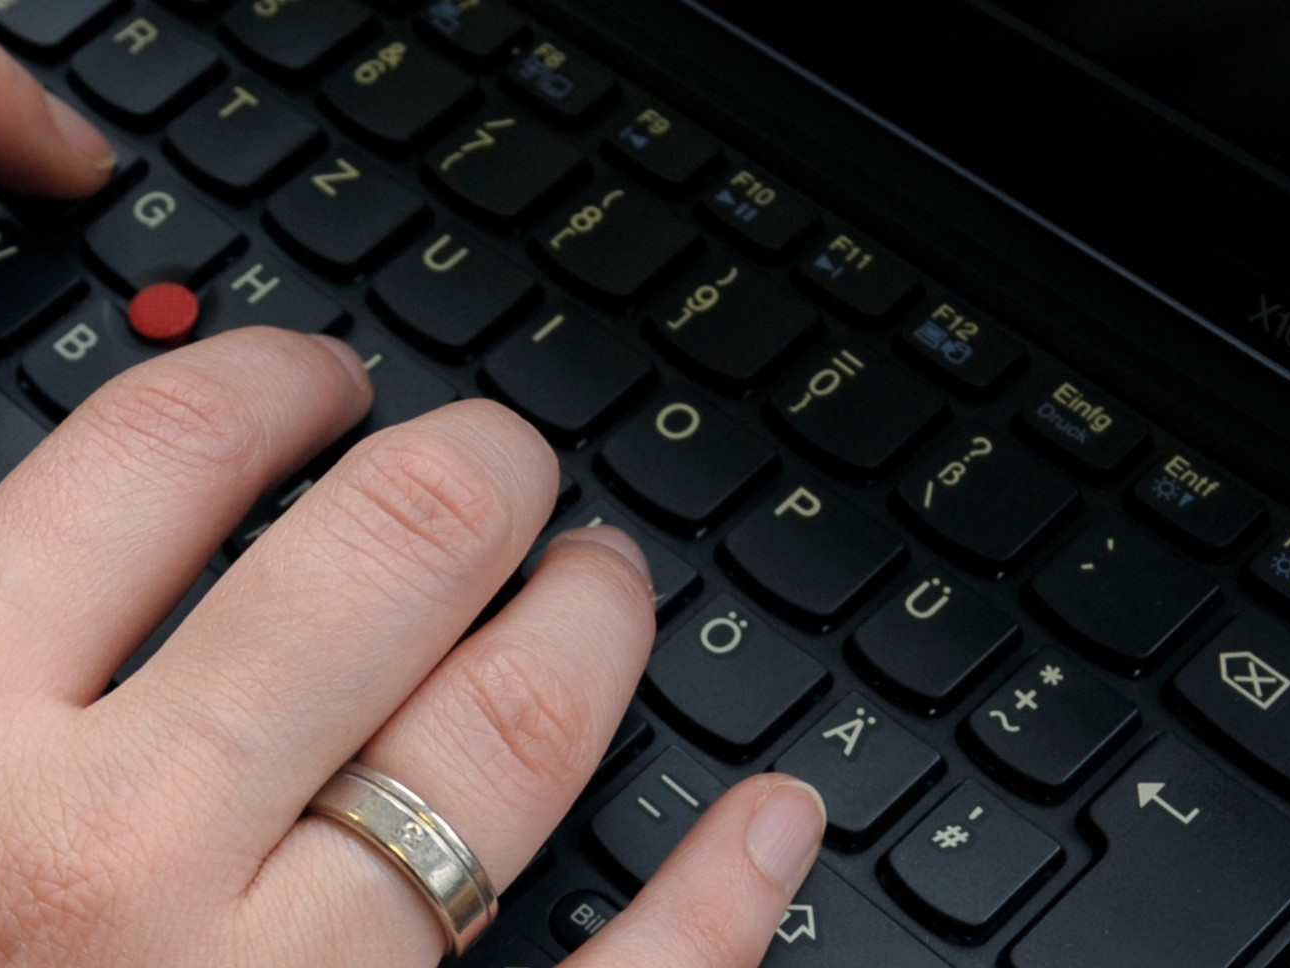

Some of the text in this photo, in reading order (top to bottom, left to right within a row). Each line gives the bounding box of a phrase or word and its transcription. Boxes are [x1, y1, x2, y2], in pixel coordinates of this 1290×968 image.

[115, 19, 157, 53] R
[220, 87, 257, 117] T
[636, 108, 671, 136] F9
[312, 159, 359, 195] Z
[730, 170, 776, 206] F10
[134, 192, 175, 227] G
[423, 235, 468, 271] U
[829, 234, 873, 270] F11
[232, 264, 279, 303] H
[931, 303, 979, 341] F12
[54, 324, 97, 360] B
[1037, 402, 1089, 444] Druck
[1052, 382, 1114, 434] Einfg
[1164, 454, 1221, 498] Entf
[774, 487, 821, 516] P
[905, 578, 951, 618] Ü
[701, 612, 747, 653] Ö
[823, 708, 875, 755] Ä
[570, 903, 606, 935] Bil
